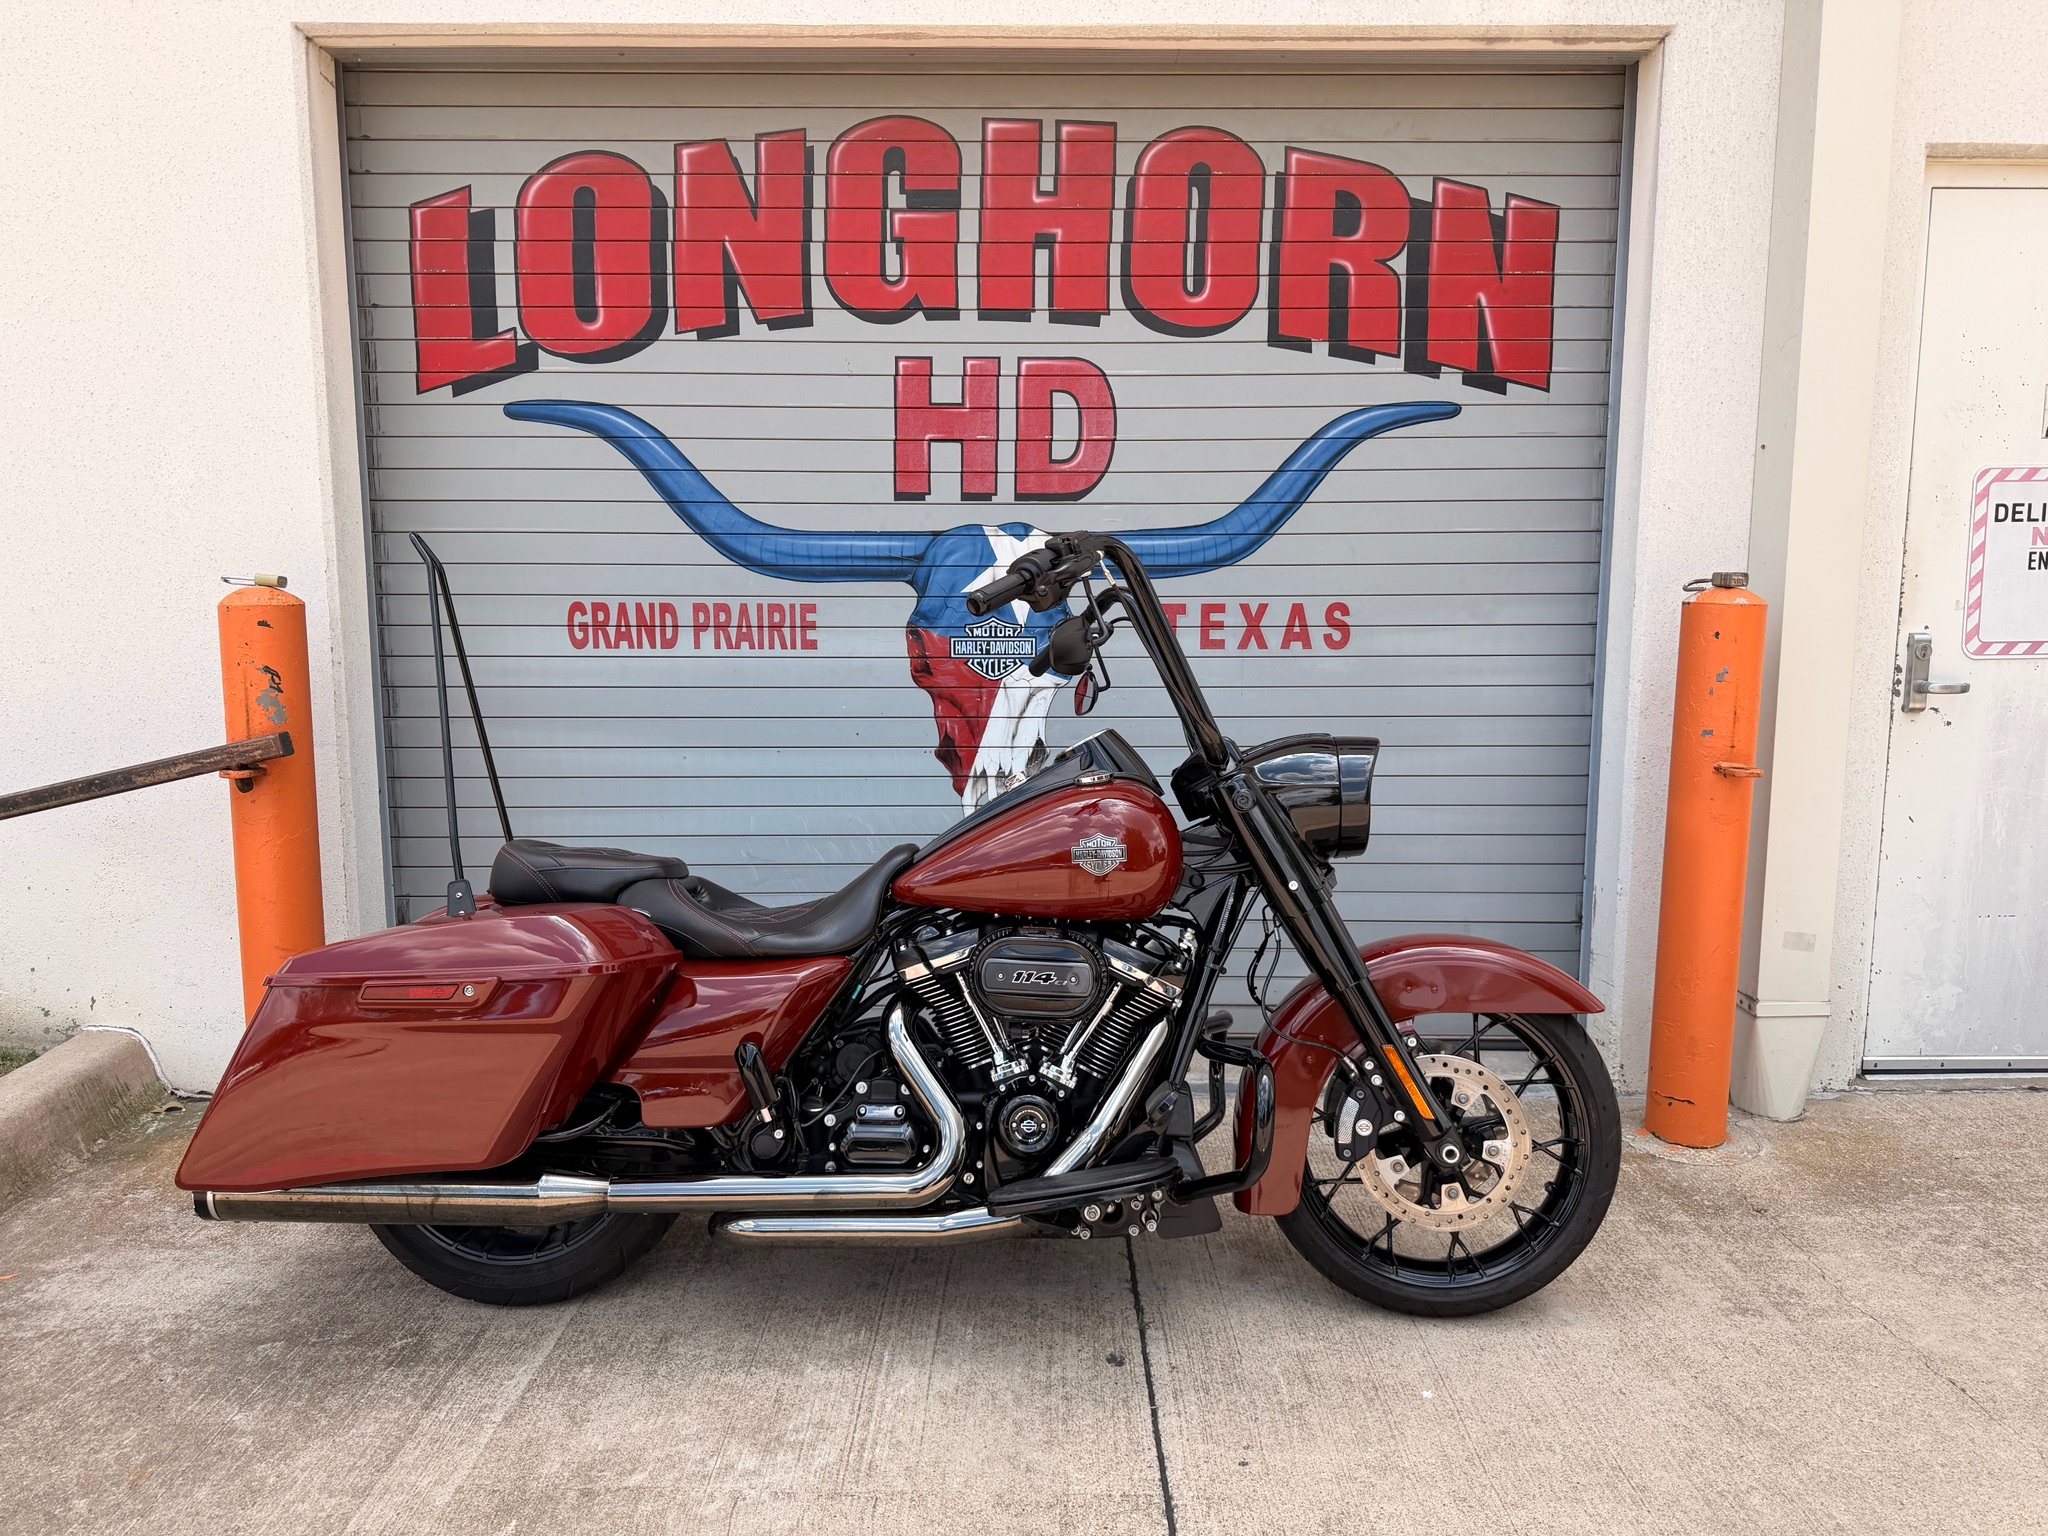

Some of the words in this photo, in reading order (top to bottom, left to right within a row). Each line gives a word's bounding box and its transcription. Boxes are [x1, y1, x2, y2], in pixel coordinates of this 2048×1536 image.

[409, 115, 1560, 396] LONGHORN
[894, 356, 1117, 501] HD
[567, 601, 678, 650] GRAND
[692, 602, 818, 650] PRAIRIE
[973, 621, 1014, 637] MOTOR
[1160, 602, 1351, 650] TEXAS
[955, 641, 1032, 655] HARLEY-DAVIDSON
[974, 659, 1014, 677] CYCLES
[1086, 838, 1112, 848] MOTOR
